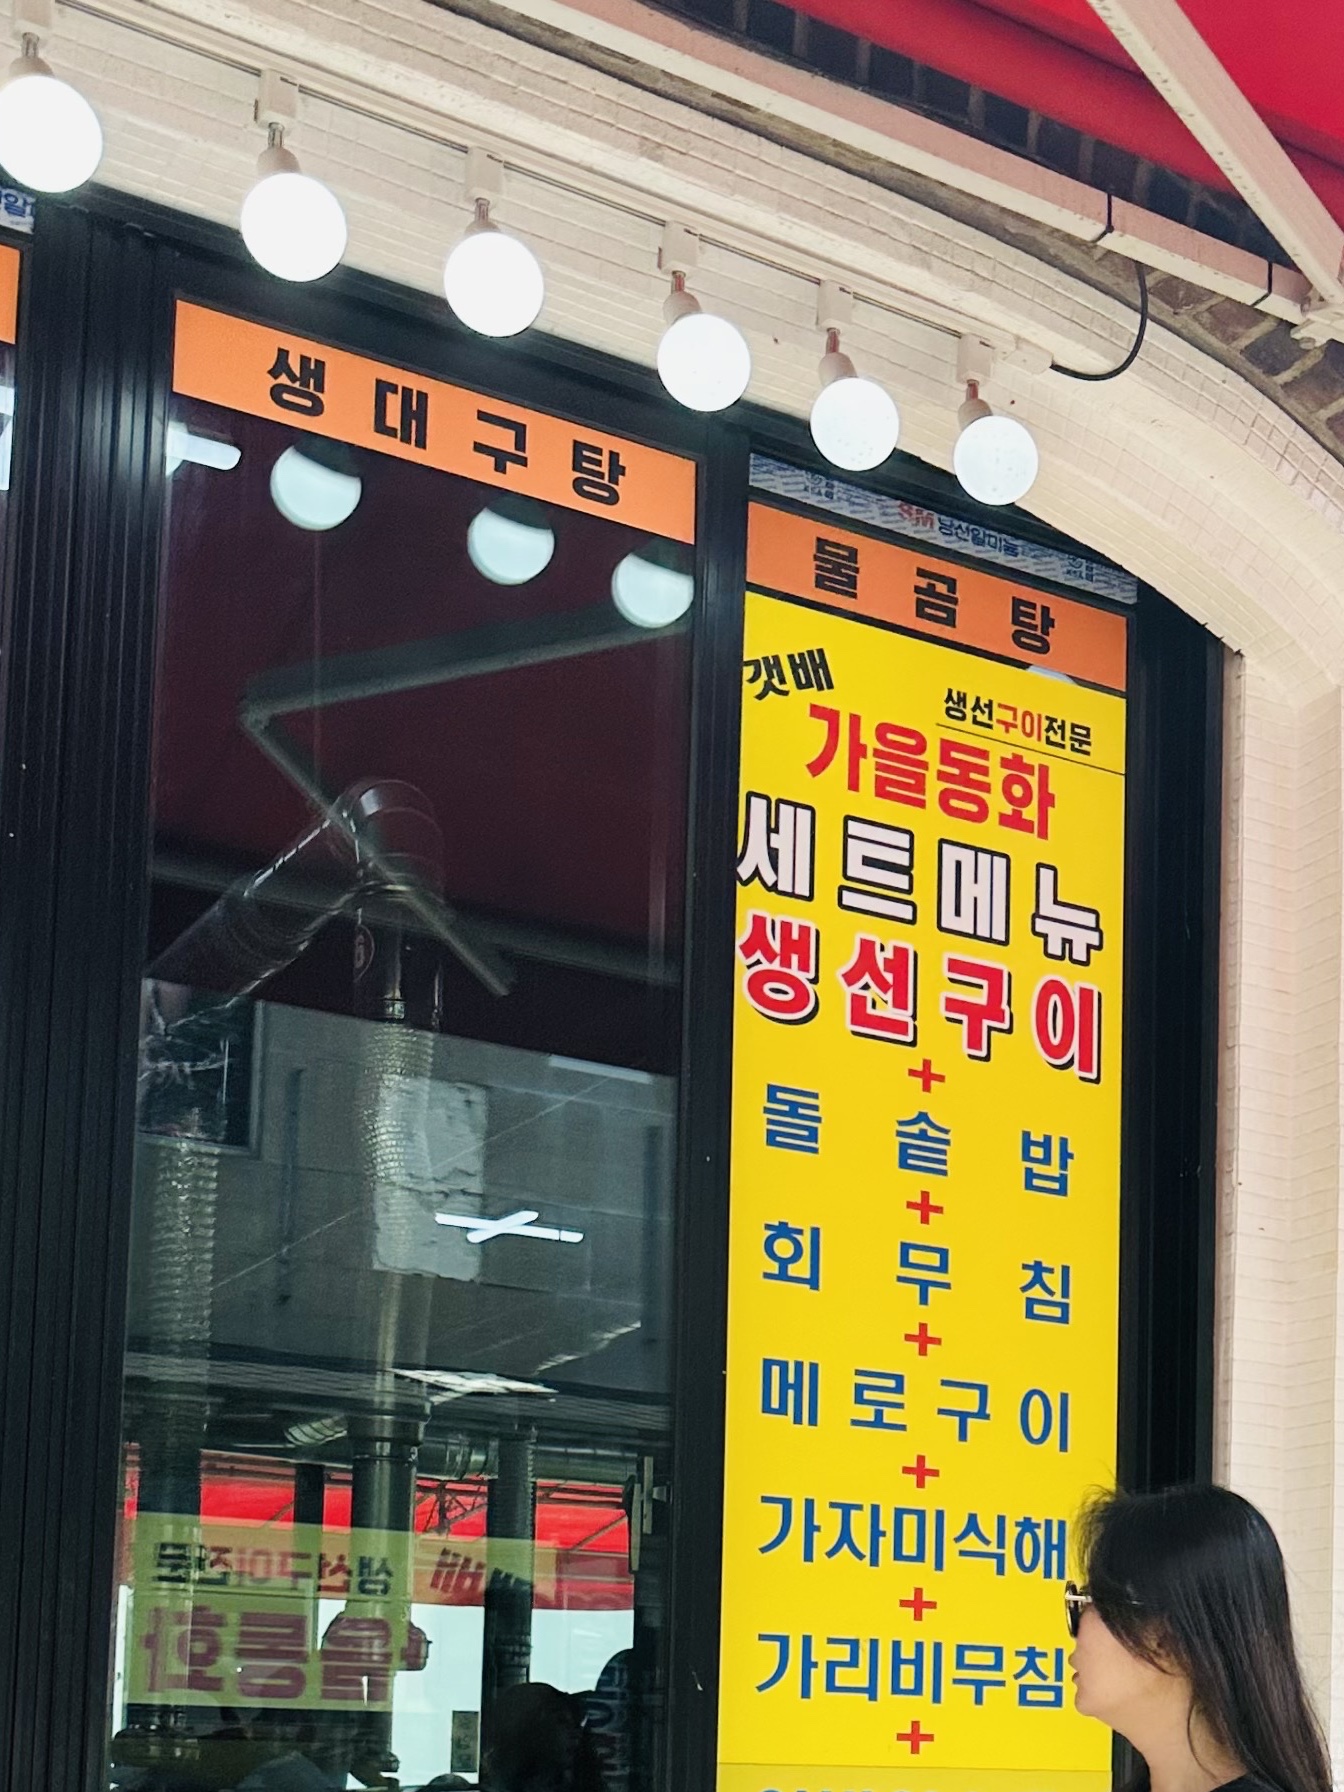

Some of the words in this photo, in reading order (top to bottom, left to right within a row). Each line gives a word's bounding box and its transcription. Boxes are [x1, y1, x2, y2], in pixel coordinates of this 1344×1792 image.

[742, 647, 834, 701] 갯배
[943, 687, 1092, 757] 생선구이전문
[805, 704, 1057, 841] 가을동화
[737, 790, 1104, 966] 세트메뉴
[738, 911, 1103, 1084] 생선구이
[758, 1494, 1067, 1581] 가자미식해
[756, 1633, 1066, 1710] 가리비무침
